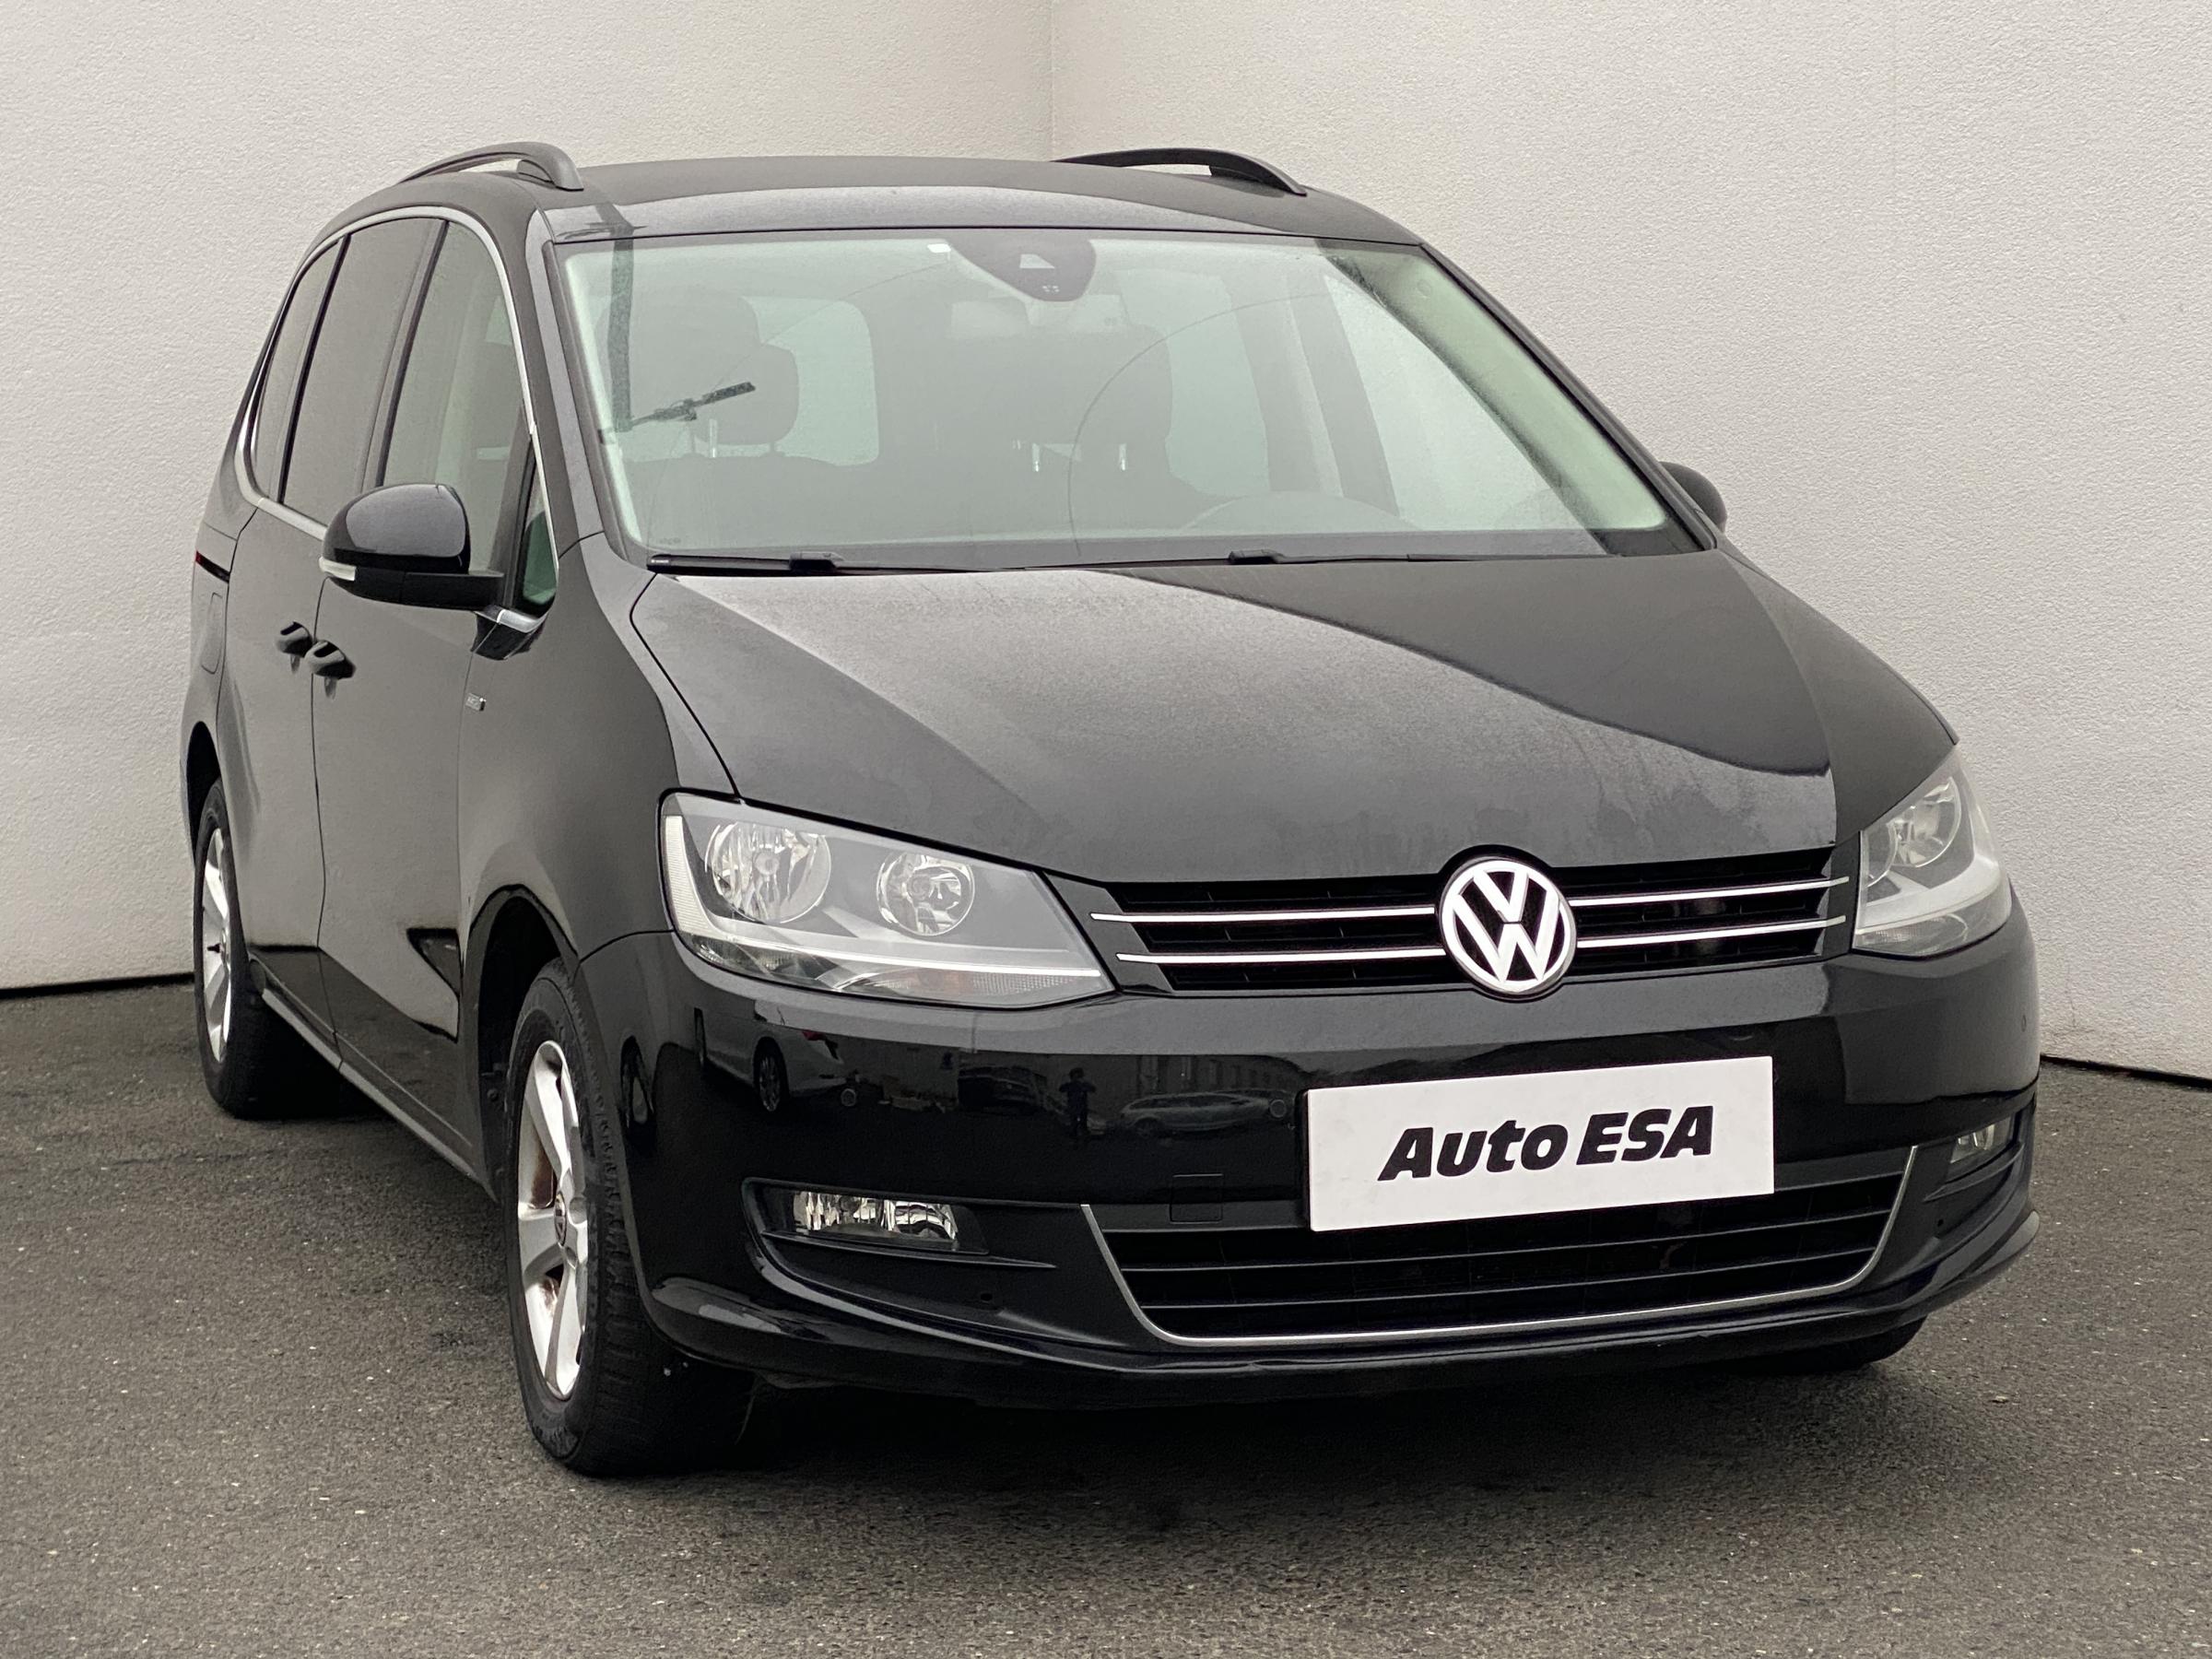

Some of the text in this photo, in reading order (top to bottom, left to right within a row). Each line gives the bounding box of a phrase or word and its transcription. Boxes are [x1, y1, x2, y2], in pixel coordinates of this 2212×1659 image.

[1444, 864, 1569, 990] VW
[1377, 1105, 1713, 1181] Auto ESA
